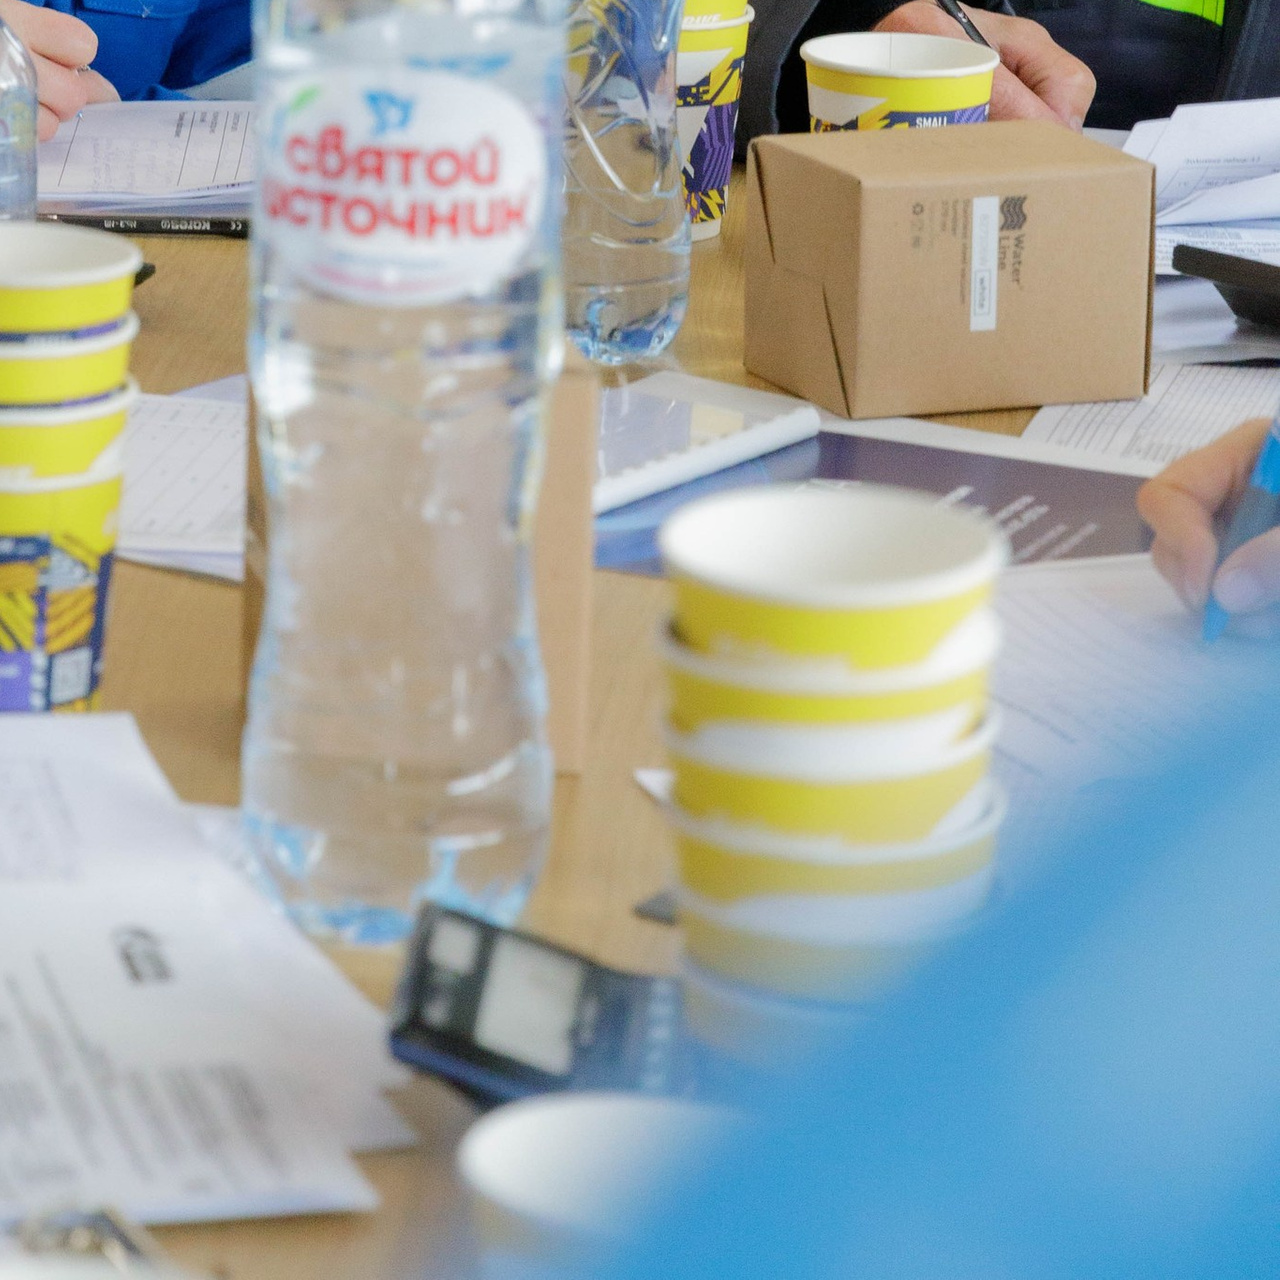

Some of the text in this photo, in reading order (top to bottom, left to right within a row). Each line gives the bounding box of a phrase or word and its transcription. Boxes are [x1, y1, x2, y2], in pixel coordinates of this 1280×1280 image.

[999, 235, 1010, 271] Line
[1011, 233, 1026, 285] Water
[978, 276, 987, 310] white
